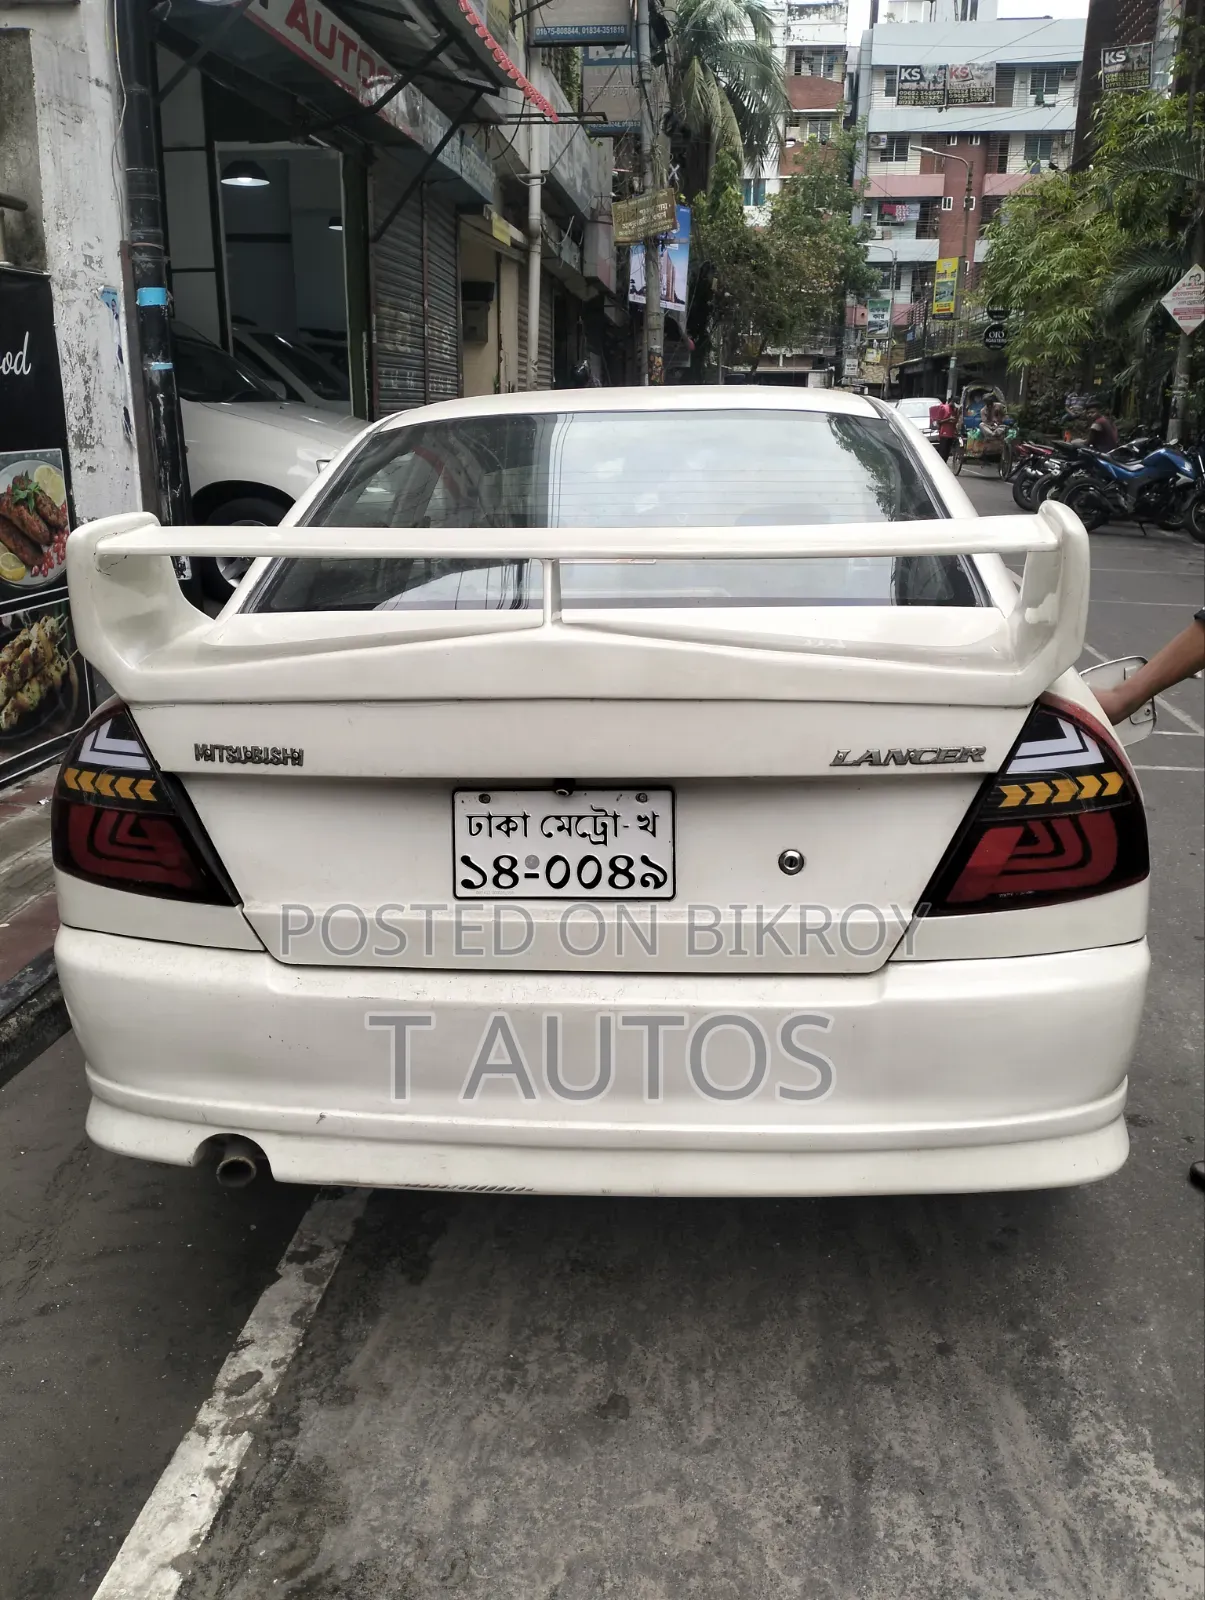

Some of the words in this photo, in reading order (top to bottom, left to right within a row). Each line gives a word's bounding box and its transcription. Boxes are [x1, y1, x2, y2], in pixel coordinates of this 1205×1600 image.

[1105, 51, 1126, 64] KS
[900, 68, 921, 80] KS
[949, 67, 969, 80] KS
[193, 743, 305, 767] MITSUBISHI
[829, 745, 987, 766] LANCER
[465, 810, 532, 839] ঢাকা
[460, 854, 668, 890] ১৪-০০৪৯
